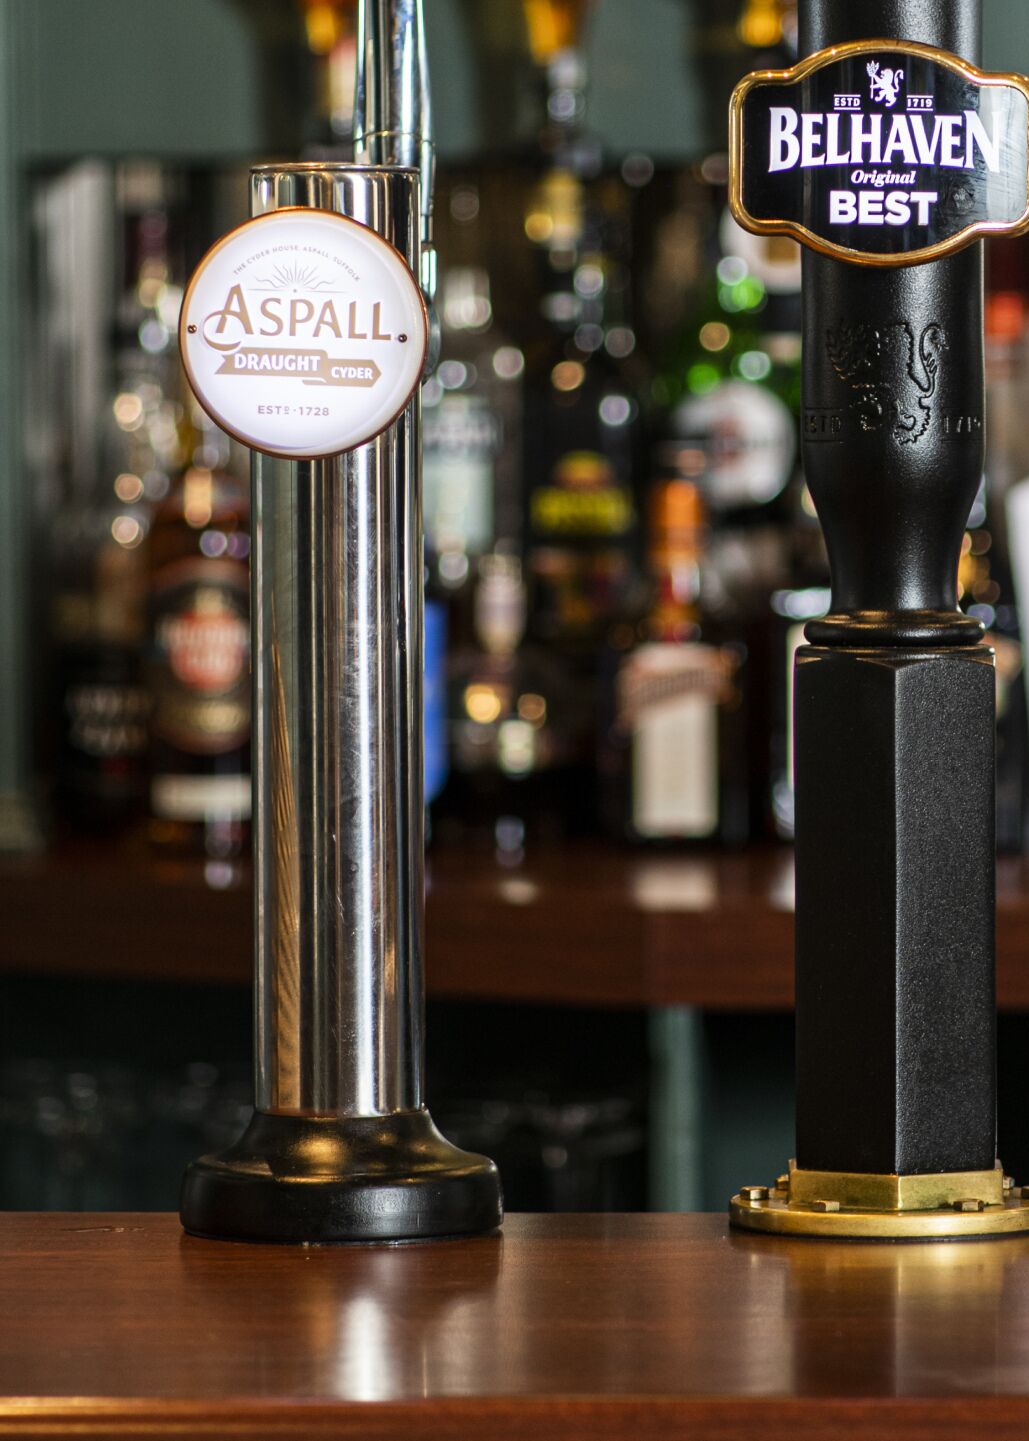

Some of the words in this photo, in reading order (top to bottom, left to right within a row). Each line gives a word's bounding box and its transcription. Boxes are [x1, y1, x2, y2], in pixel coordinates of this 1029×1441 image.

[834, 97, 861, 107] ESTD
[906, 97, 933, 108] 1719
[768, 107, 1001, 173] BELHAVEN
[850, 170, 917, 187] Original
[829, 191, 938, 225] BEST
[246, 249, 270, 265] CYDER
[272, 244, 299, 253] HOUSE
[302, 246, 329, 259] ASPALL
[203, 283, 392, 351] ASPALL
[234, 353, 321, 371] DRAUGHT
[331, 365, 373, 380] CYDER
[299, 406, 330, 417] 1728
